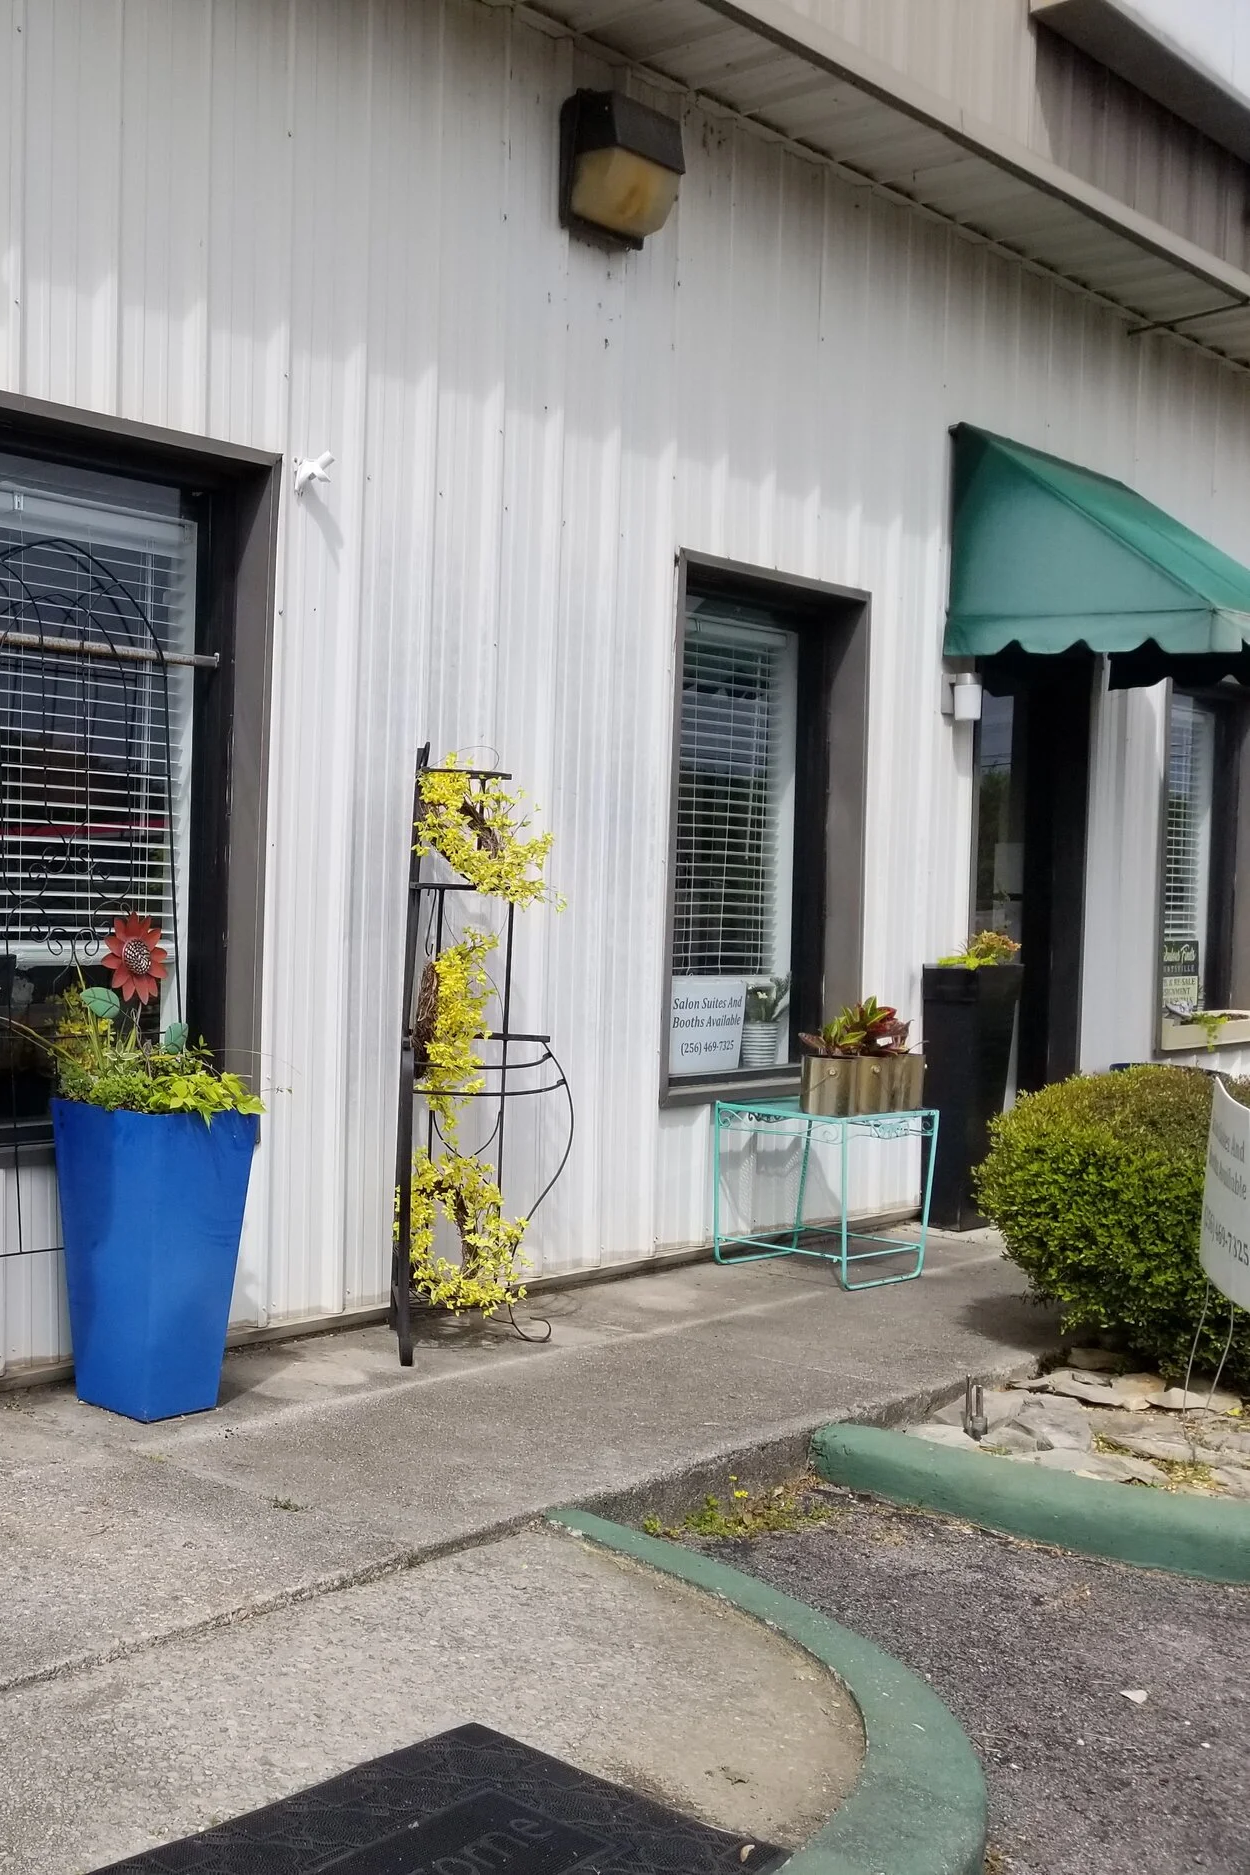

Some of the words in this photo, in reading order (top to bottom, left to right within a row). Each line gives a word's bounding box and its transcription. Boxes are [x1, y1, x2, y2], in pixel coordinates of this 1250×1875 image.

[672, 997, 700, 1010] Salon
[701, 997, 727, 1009] Suites
[728, 996, 742, 1008] And
[672, 1016, 704, 1029] Booths
[706, 1014, 741, 1027] Available
[680, 1042, 702, 1056] (256)
[703, 1040, 734, 1052] 469-7325
